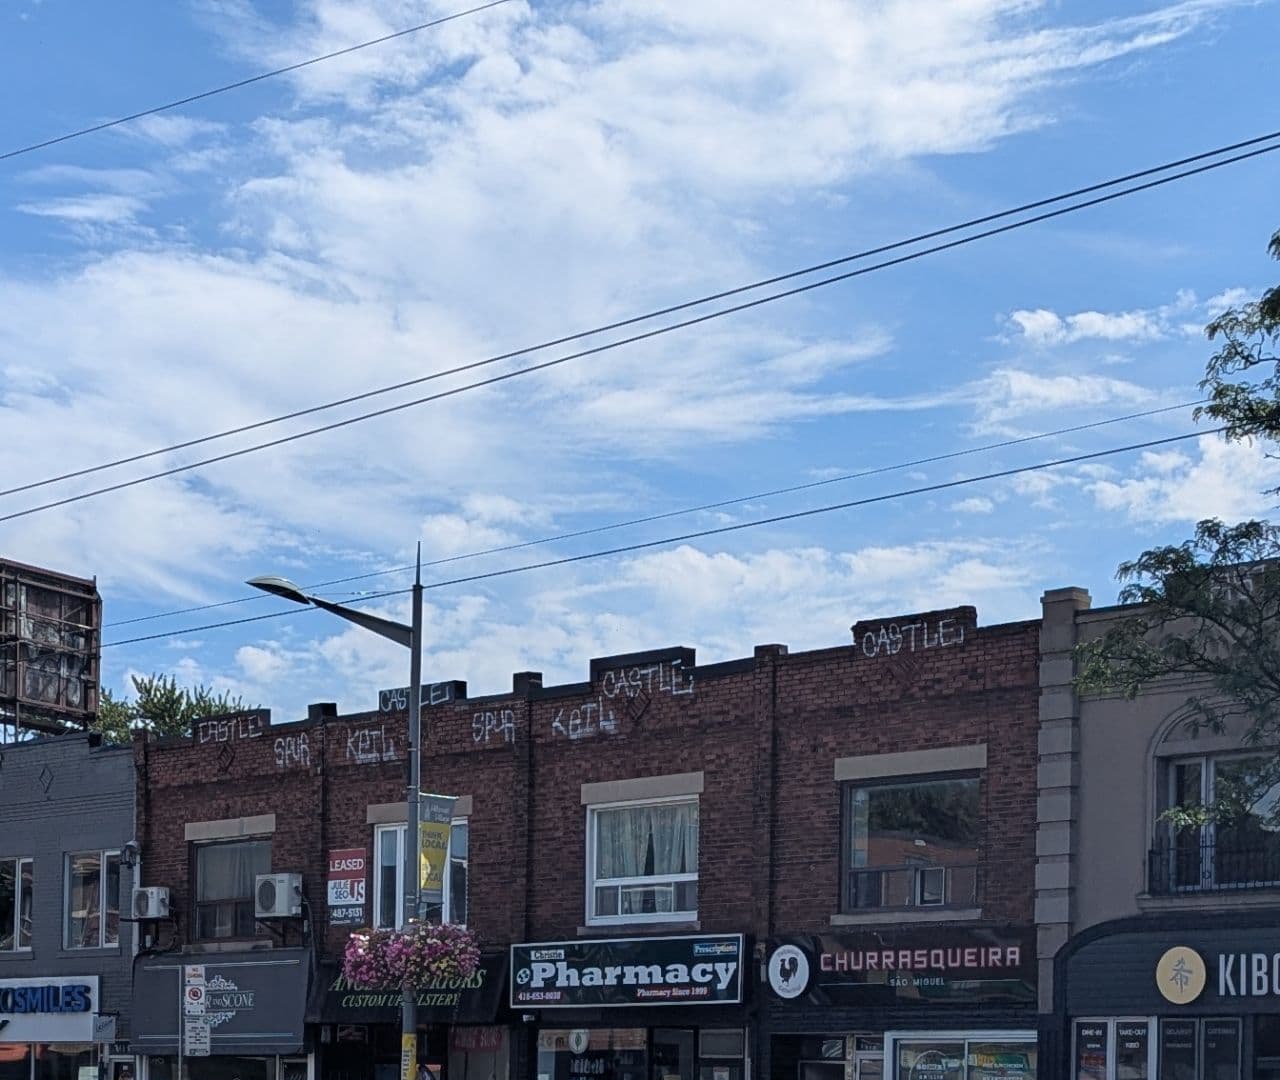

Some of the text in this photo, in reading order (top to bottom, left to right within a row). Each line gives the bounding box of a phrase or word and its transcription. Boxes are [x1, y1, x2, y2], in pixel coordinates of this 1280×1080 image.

[329, 859, 364, 872] LEASED
[335, 889, 349, 899] SEO
[820, 947, 1020, 972] CHURRASQUEIRA
[530, 961, 737, 990] Pharmacy
[913, 977, 945, 987] MIGUEL
[637, 988, 670, 998] Pharmacy
[671, 988, 690, 996] Since
[222, 992, 255, 1008] SCONE
[342, 994, 389, 1007] CUSTOM
